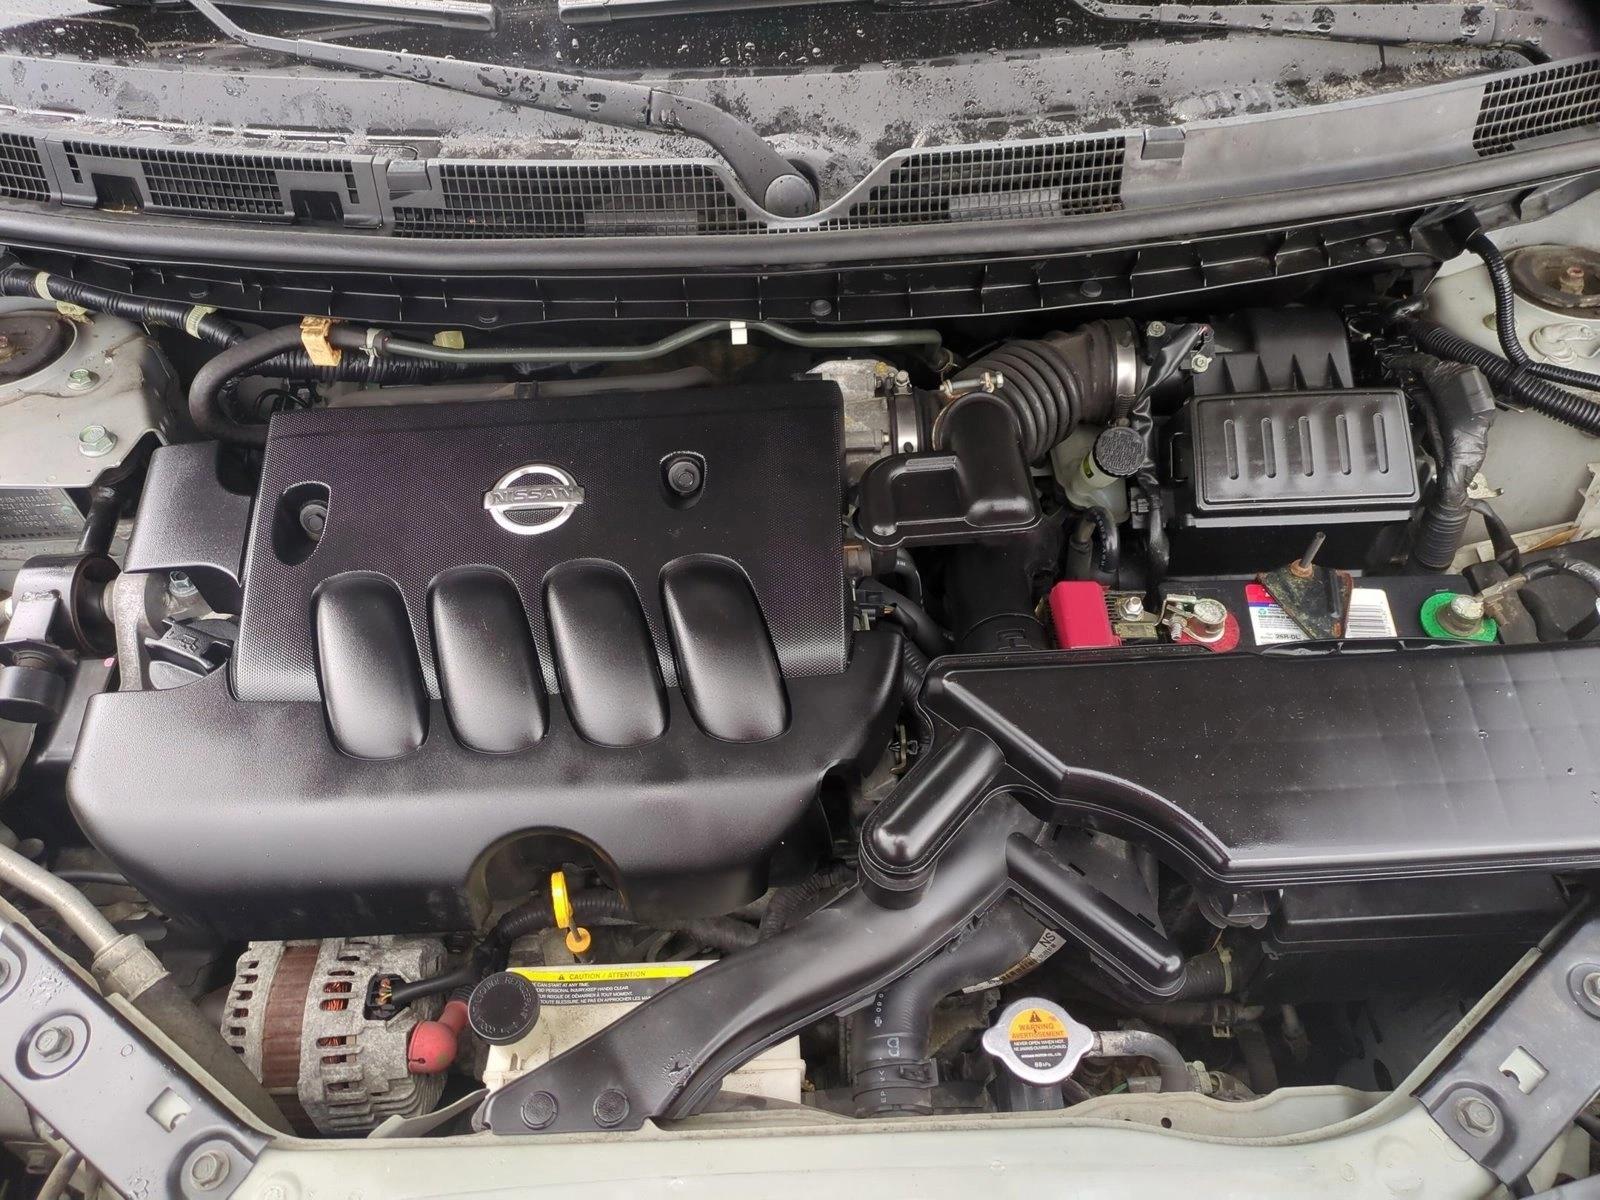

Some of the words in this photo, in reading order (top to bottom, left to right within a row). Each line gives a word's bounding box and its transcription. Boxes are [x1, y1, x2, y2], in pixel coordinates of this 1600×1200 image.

[493, 487, 573, 503] NISSAN
[1039, 932, 1056, 948] NS
[608, 971, 646, 979] ATTENTION
[1018, 1022, 1054, 1030] WARNING
[1012, 1031, 1064, 1039] AVERTISSEMENT
